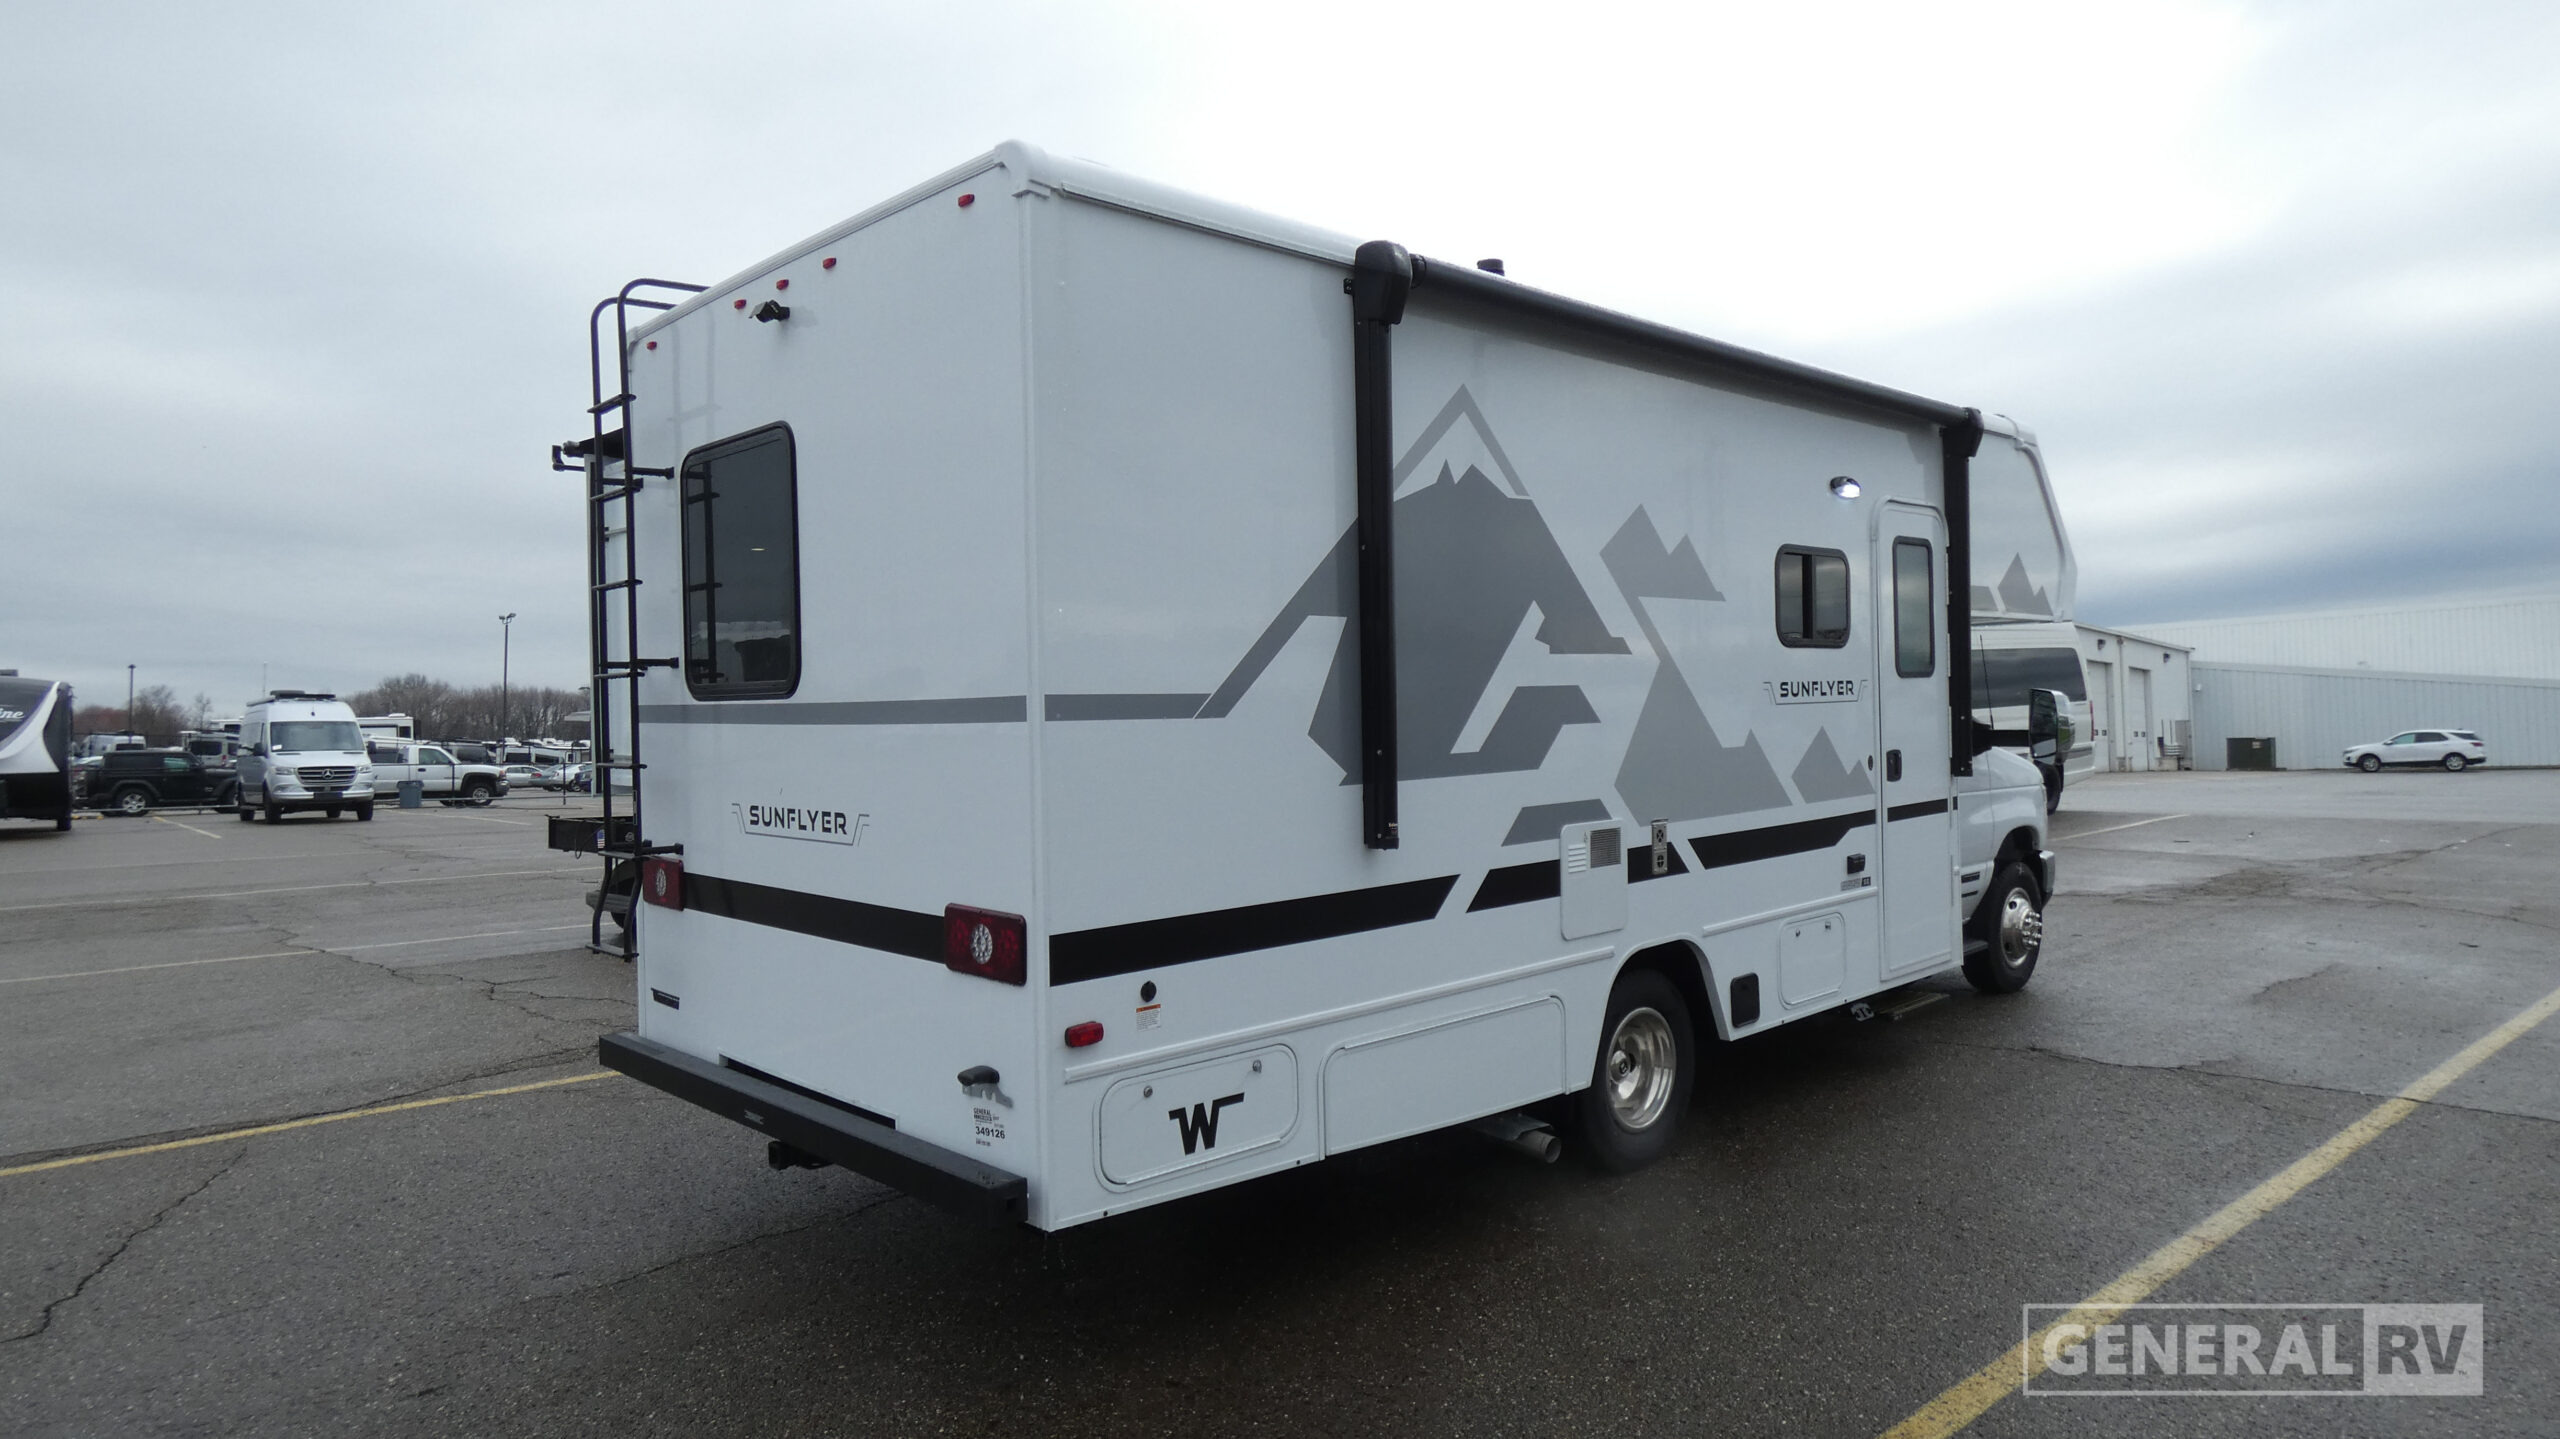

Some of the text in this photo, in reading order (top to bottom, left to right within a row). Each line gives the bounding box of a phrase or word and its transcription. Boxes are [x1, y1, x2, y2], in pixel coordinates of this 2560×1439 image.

[1780, 680, 1854, 697] SUNFLYER
[749, 805, 847, 835] SUNFLYER
[975, 1126, 1005, 1140] 349126
[1168, 1092, 1245, 1156] W
